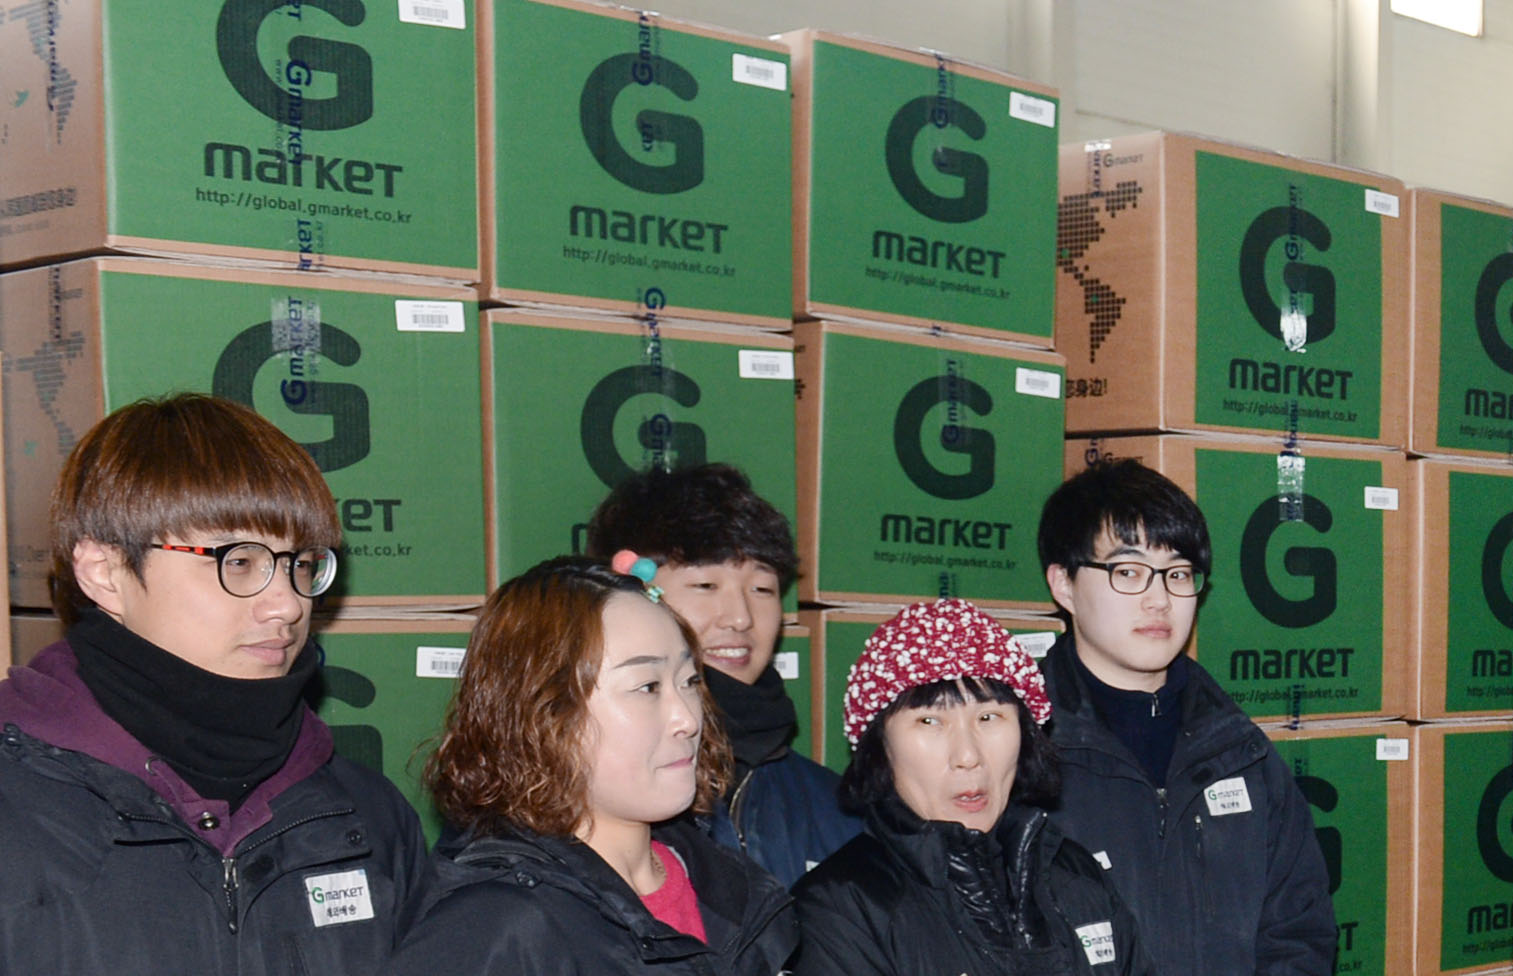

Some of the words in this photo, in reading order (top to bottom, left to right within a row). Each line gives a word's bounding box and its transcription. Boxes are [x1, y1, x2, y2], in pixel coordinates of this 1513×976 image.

[215, 0, 373, 131] G
[579, 52, 703, 194] G
[204, 142, 403, 198] market
[886, 95, 989, 223] G
[195, 187, 412, 224] http://global.gmarket.co.kr
[569, 206, 728, 254] market
[562, 246, 735, 276] http://global.gmarket.co.kr
[873, 230, 1006, 279] market
[1239, 206, 1336, 345] G
[866, 267, 1010, 298] http://global.gmarket.co.kr
[1229, 358, 1352, 400] market
[893, 375, 997, 499] G
[881, 514, 1012, 550] market
[873, 550, 1016, 569] http://global.gmarket.co.kr
[1240, 493, 1337, 628] G
[1230, 648, 1353, 680] market
[312, 887, 363, 903] Gmarket
